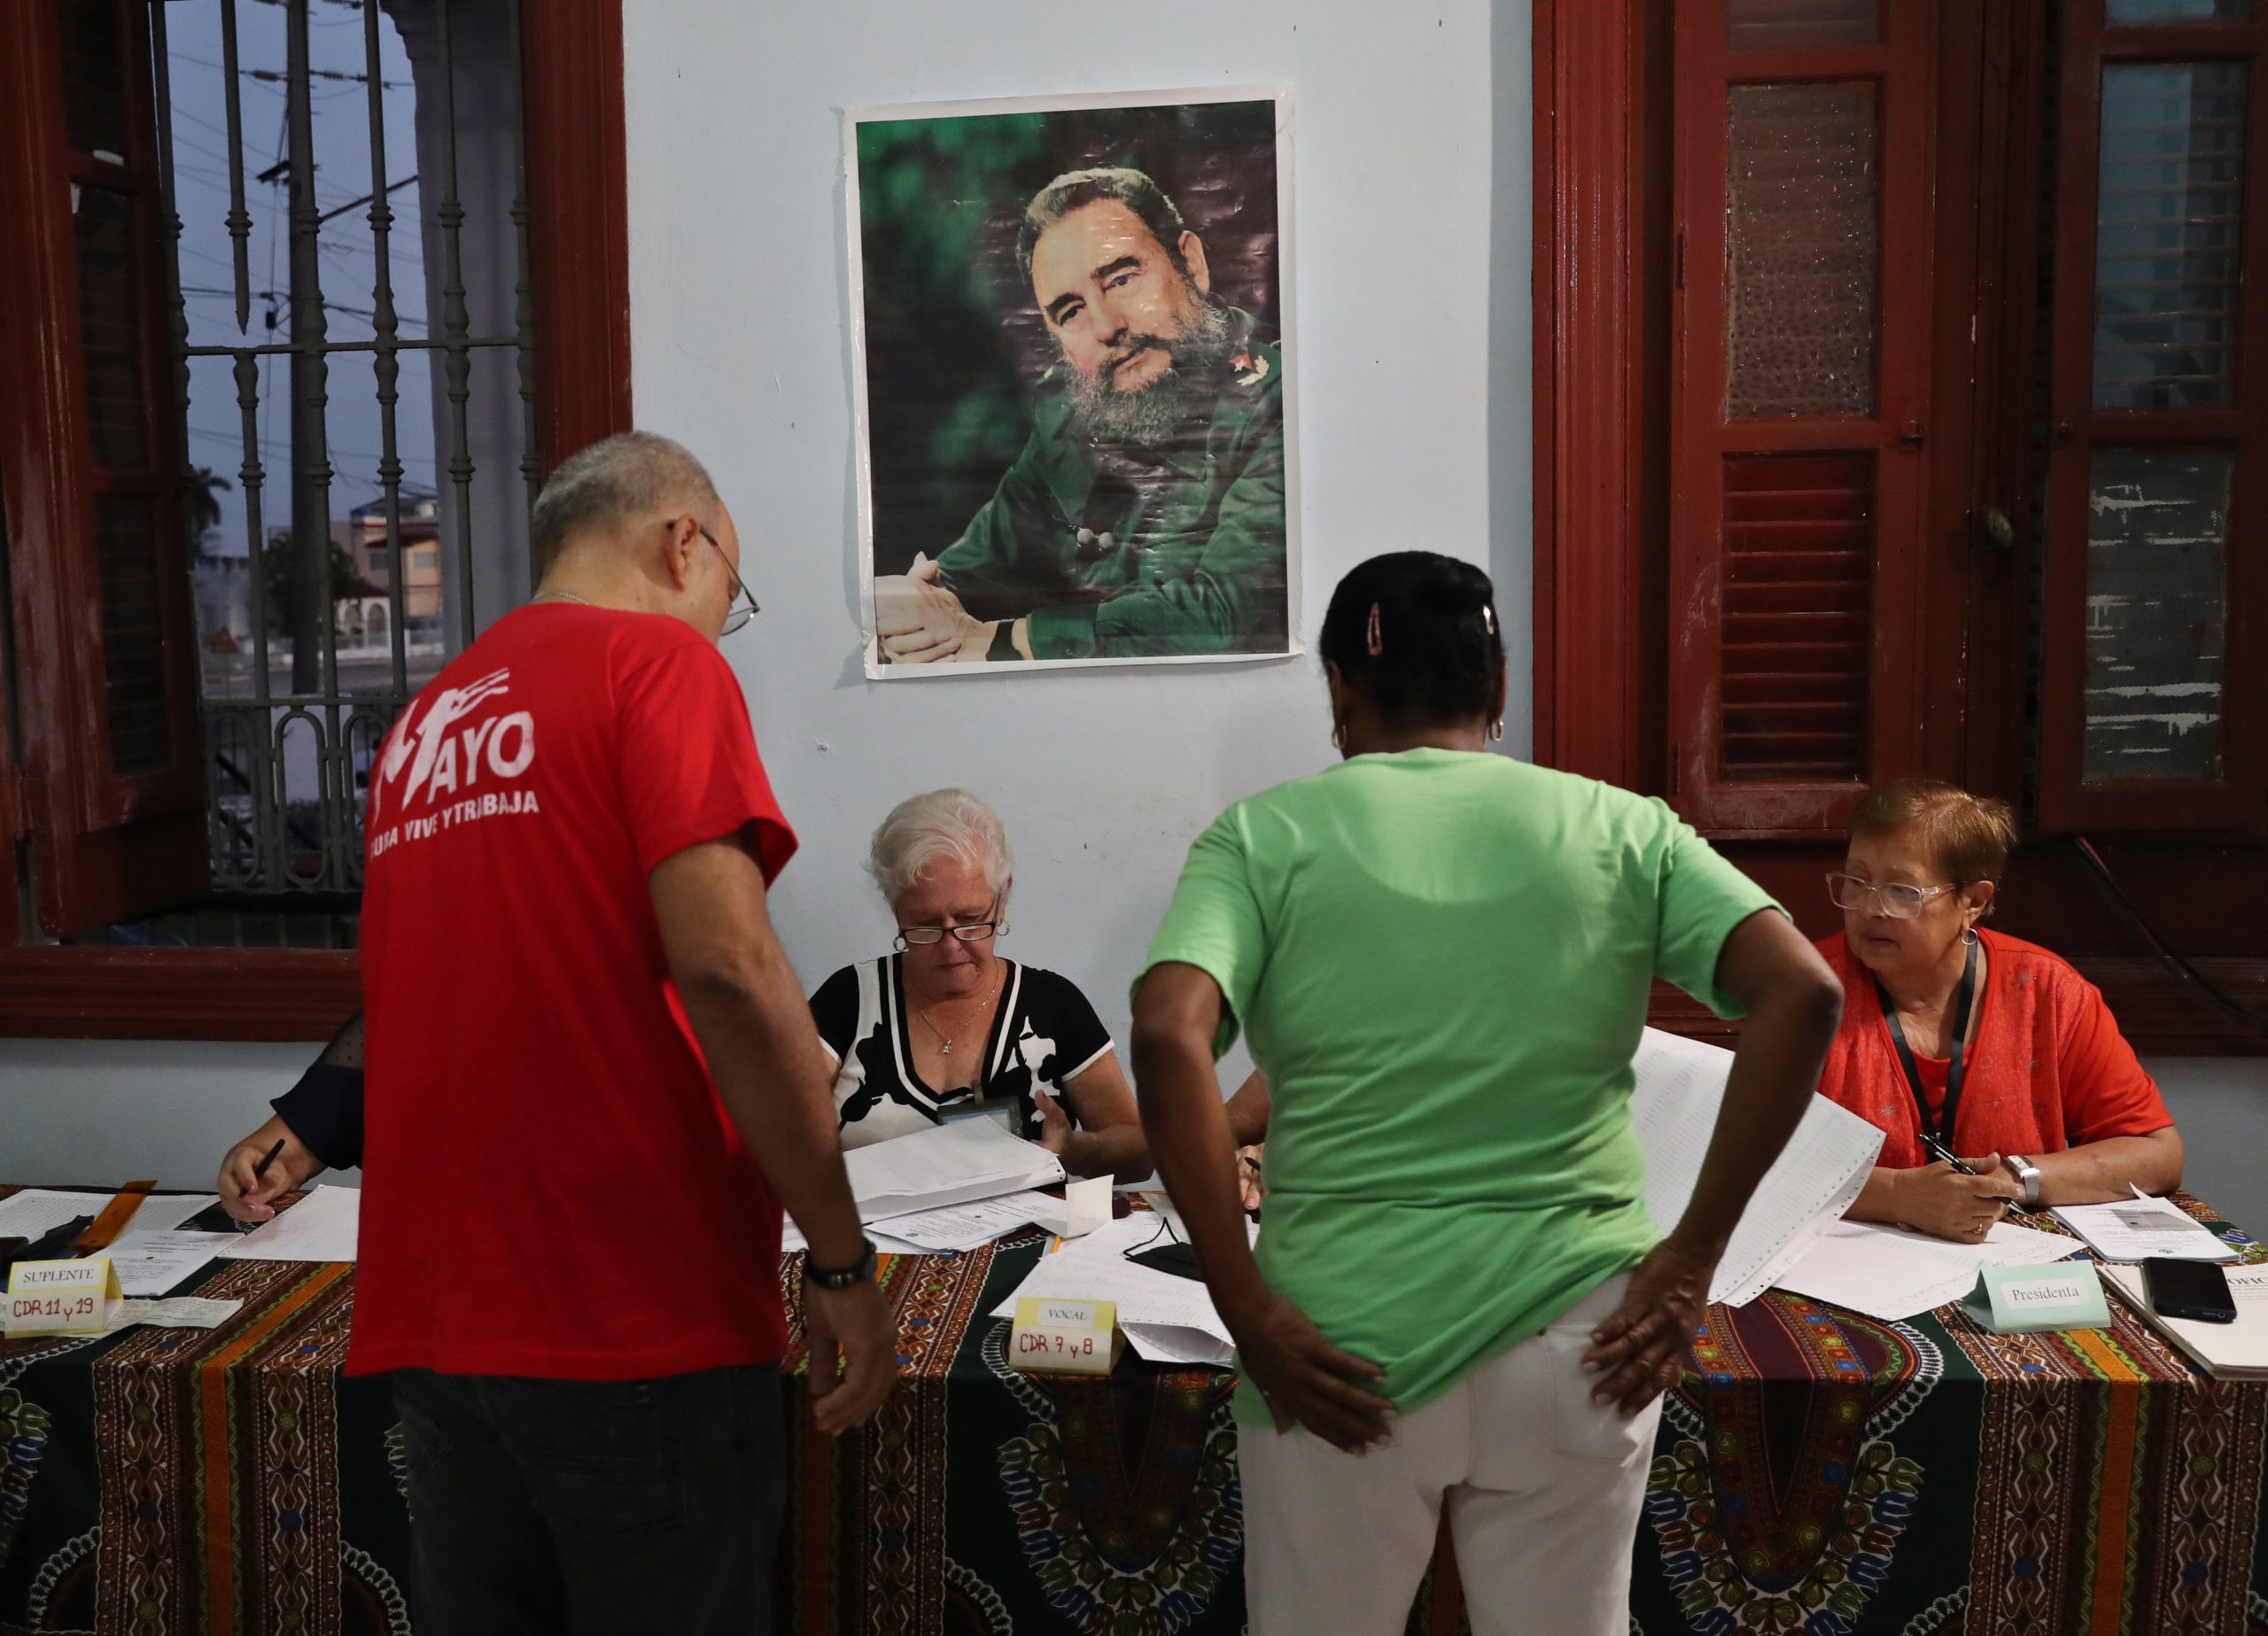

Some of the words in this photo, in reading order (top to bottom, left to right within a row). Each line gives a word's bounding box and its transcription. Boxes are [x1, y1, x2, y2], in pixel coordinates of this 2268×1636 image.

[404, 811, 439, 842] VIVE
[22, 1268, 95, 1283] SUPLENTE
[2011, 1285, 2080, 1301] Presidenta
[13, 1298, 43, 1318] CDR
[45, 1298, 61, 1314] 11
[75, 1297, 94, 1314] 19
[1048, 1309, 1086, 1321] VOCAL
[1020, 1333, 1048, 1353] CDR
[1055, 1336, 1063, 1353] 7
[1083, 1337, 1092, 1355] 8
